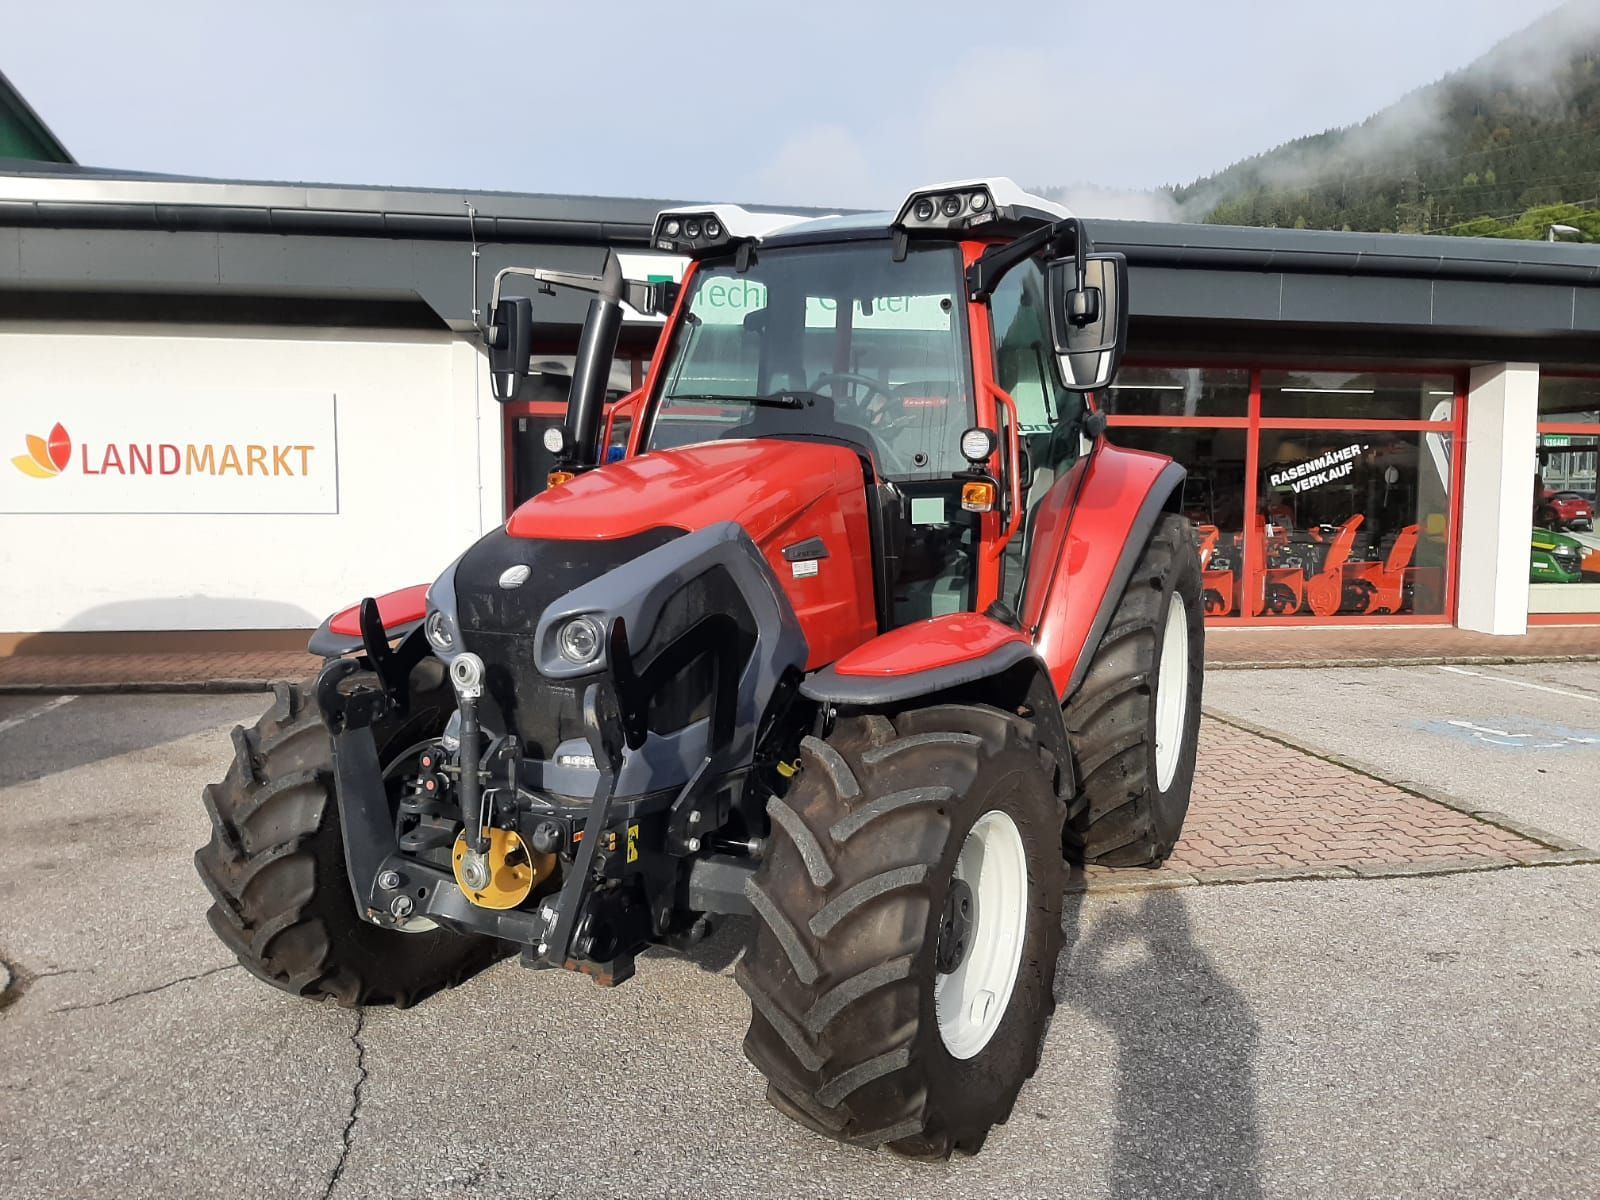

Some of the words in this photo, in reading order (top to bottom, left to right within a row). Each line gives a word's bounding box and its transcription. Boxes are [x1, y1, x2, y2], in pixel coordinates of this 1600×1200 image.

[81, 443, 315, 477] LANDMARKT
[1270, 444, 1361, 487] RASENMÄHER
[1291, 461, 1354, 494] VERKAUF
